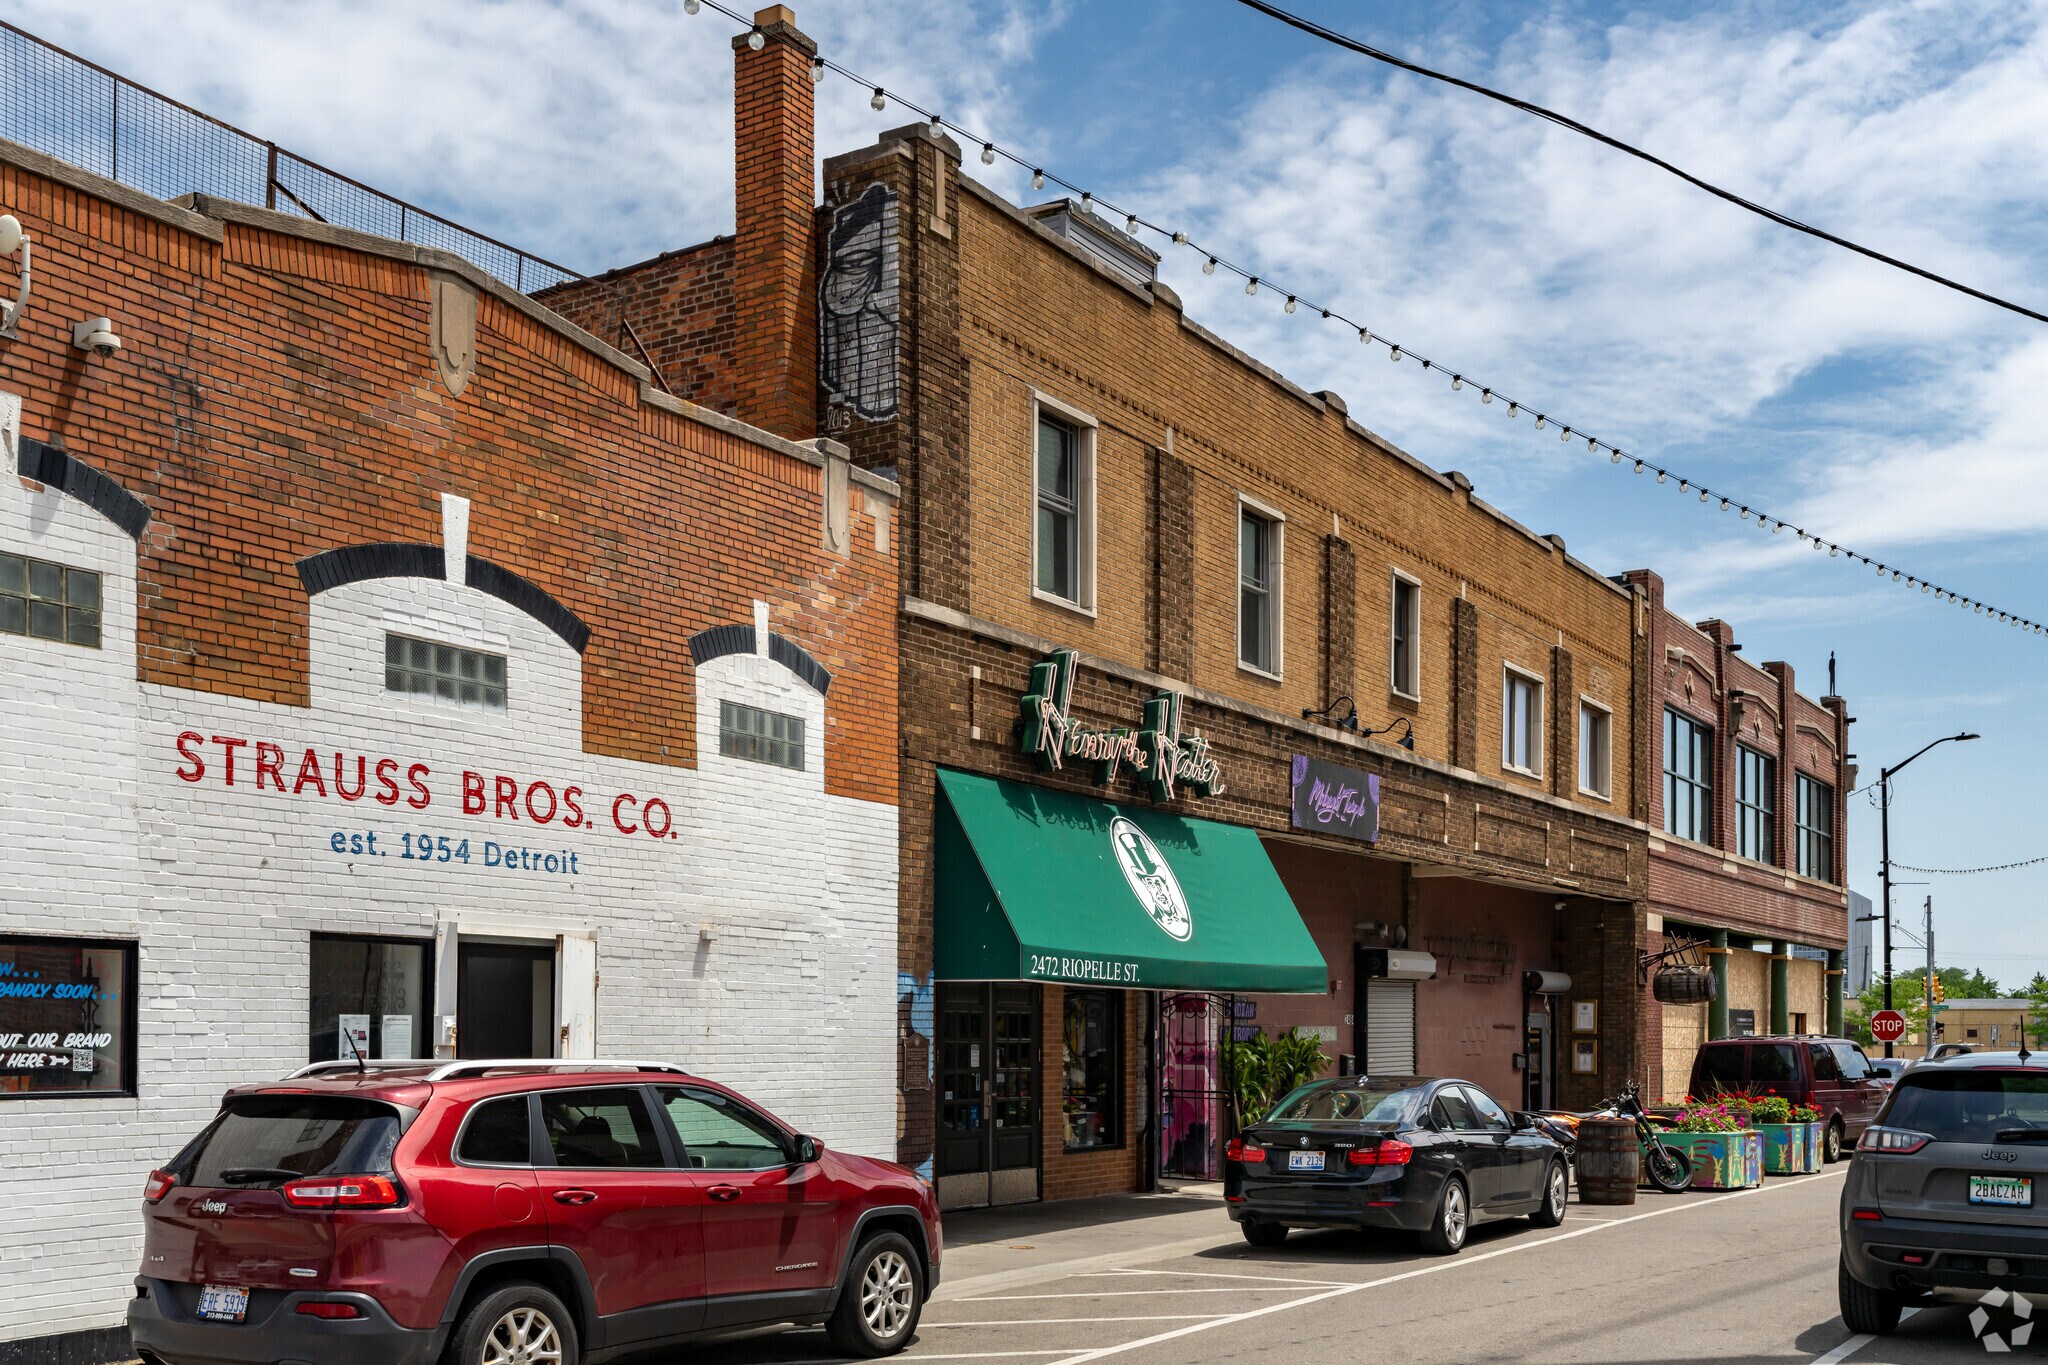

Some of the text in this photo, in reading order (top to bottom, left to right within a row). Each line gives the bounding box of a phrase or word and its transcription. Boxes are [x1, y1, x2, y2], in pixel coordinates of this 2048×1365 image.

[176, 730, 677, 839] STRAUSS BROS. CO.
[331, 831, 579, 875] est. 1954 Detroit
[1031, 955, 1140, 982] 2472 RIOPELLE ST.
[1873, 1020, 1902, 1032] STOP
[28, 1032, 59, 1048] OUR
[63, 1032, 112, 1048] BRAND
[7, 1053, 47, 1068] HERE
[1307, 1156, 1323, 1166] 2139
[1982, 1150, 2017, 1163] Jeep
[1976, 1183, 2024, 1199] 2BACZAR
[202, 1199, 227, 1214] Jeep
[775, 1261, 818, 1271] CHEROKEE
[223, 1294, 246, 1313] 5939
